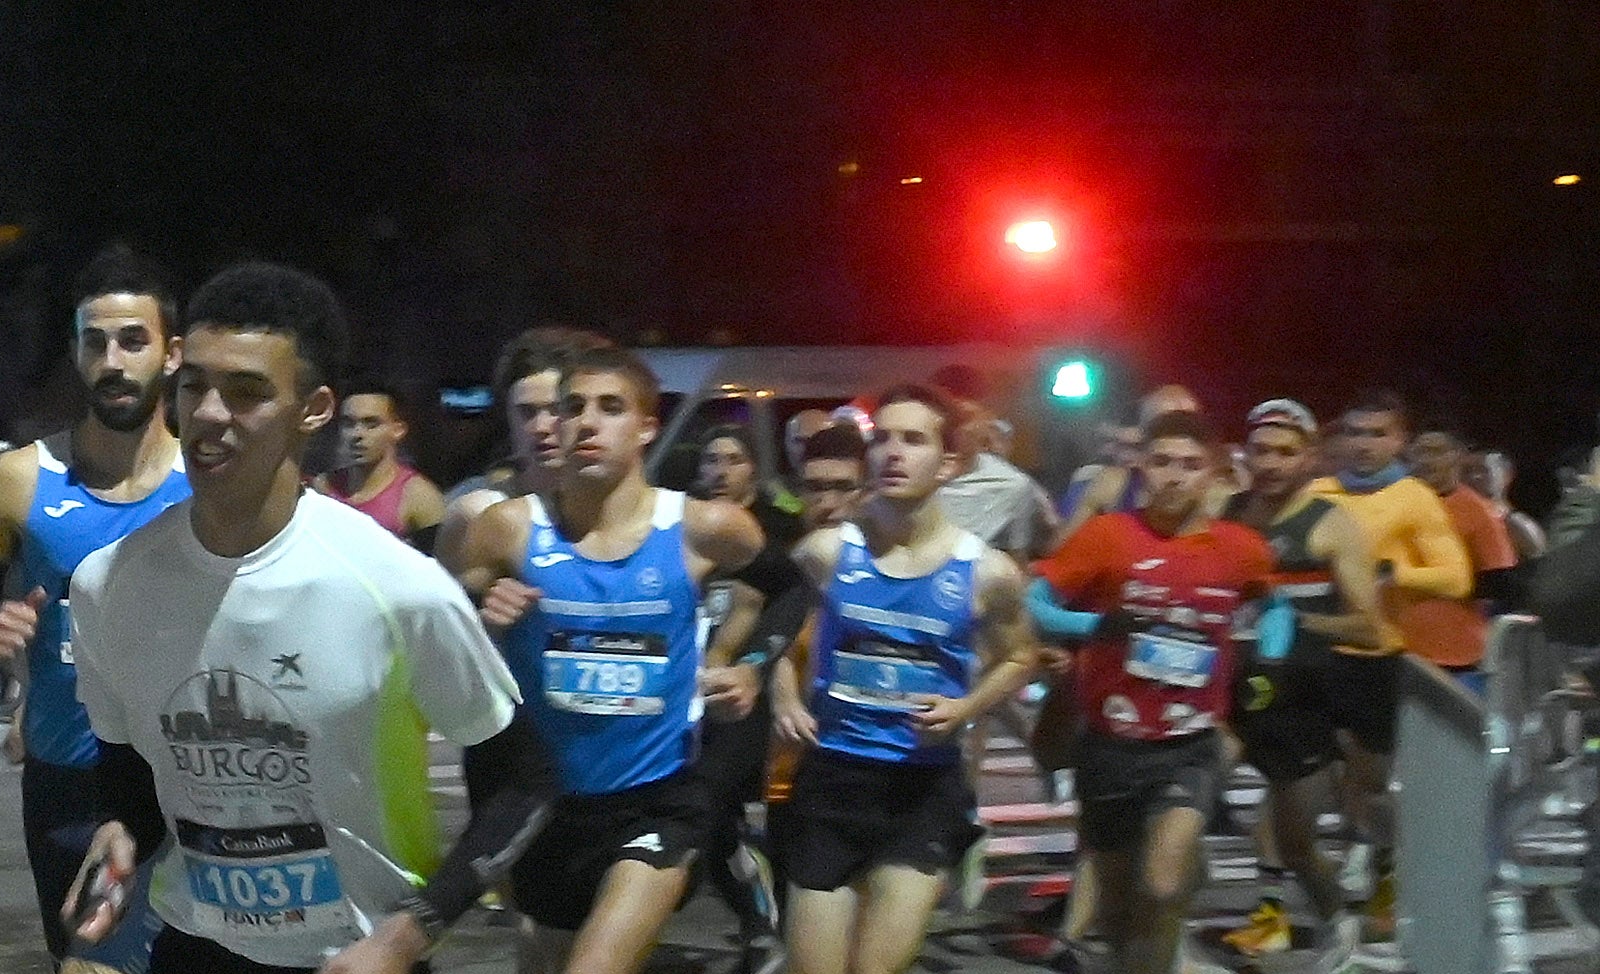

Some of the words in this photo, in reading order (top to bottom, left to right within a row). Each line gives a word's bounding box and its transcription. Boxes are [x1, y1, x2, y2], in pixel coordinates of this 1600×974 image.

[575, 661, 644, 693] 789
[169, 745, 311, 785] BURGOS
[206, 863, 315, 907] 1037
